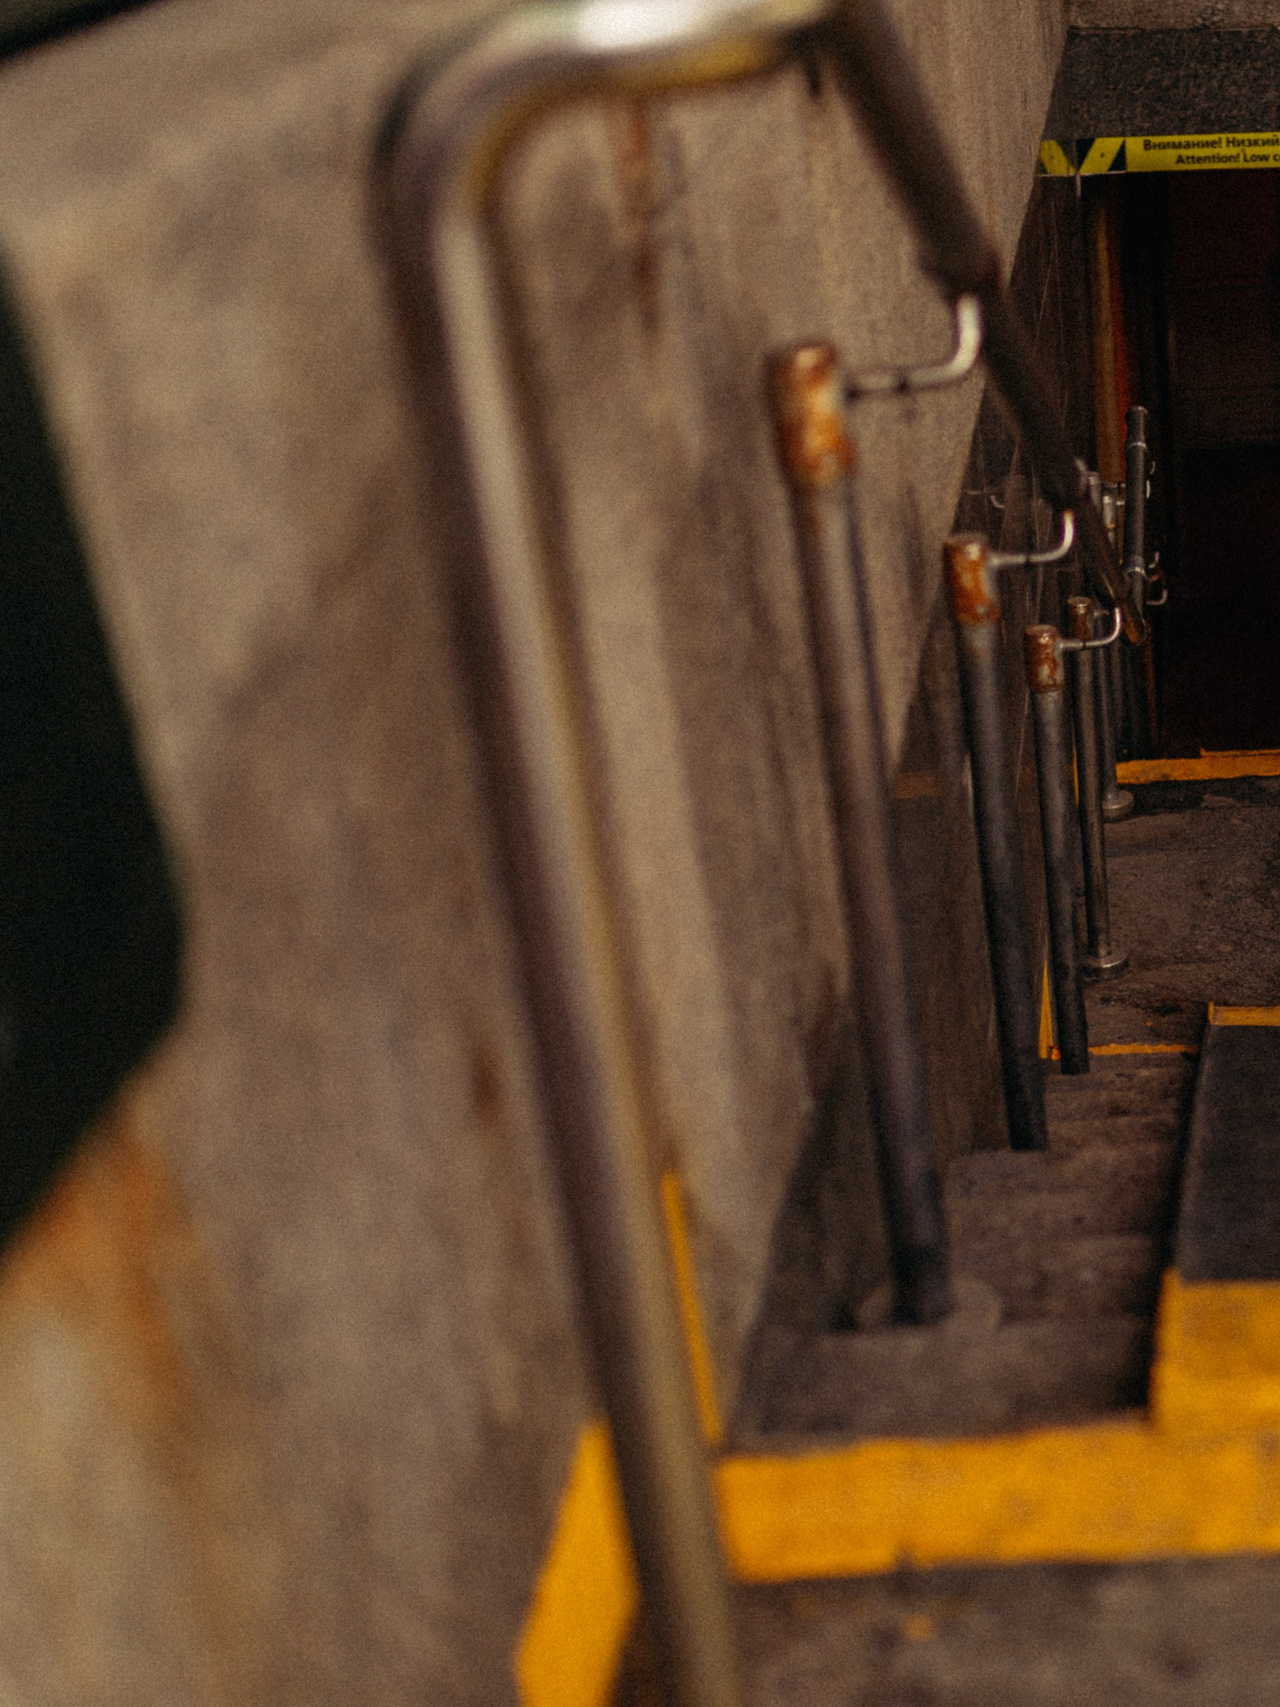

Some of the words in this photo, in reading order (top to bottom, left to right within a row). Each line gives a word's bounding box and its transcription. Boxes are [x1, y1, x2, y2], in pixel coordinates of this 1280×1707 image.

[1143, 137, 1223, 151] Внимание!
[1226, 134, 1280, 148] Низкий
[1175, 152, 1241, 165] Attention!
[1243, 150, 1270, 163] Low
